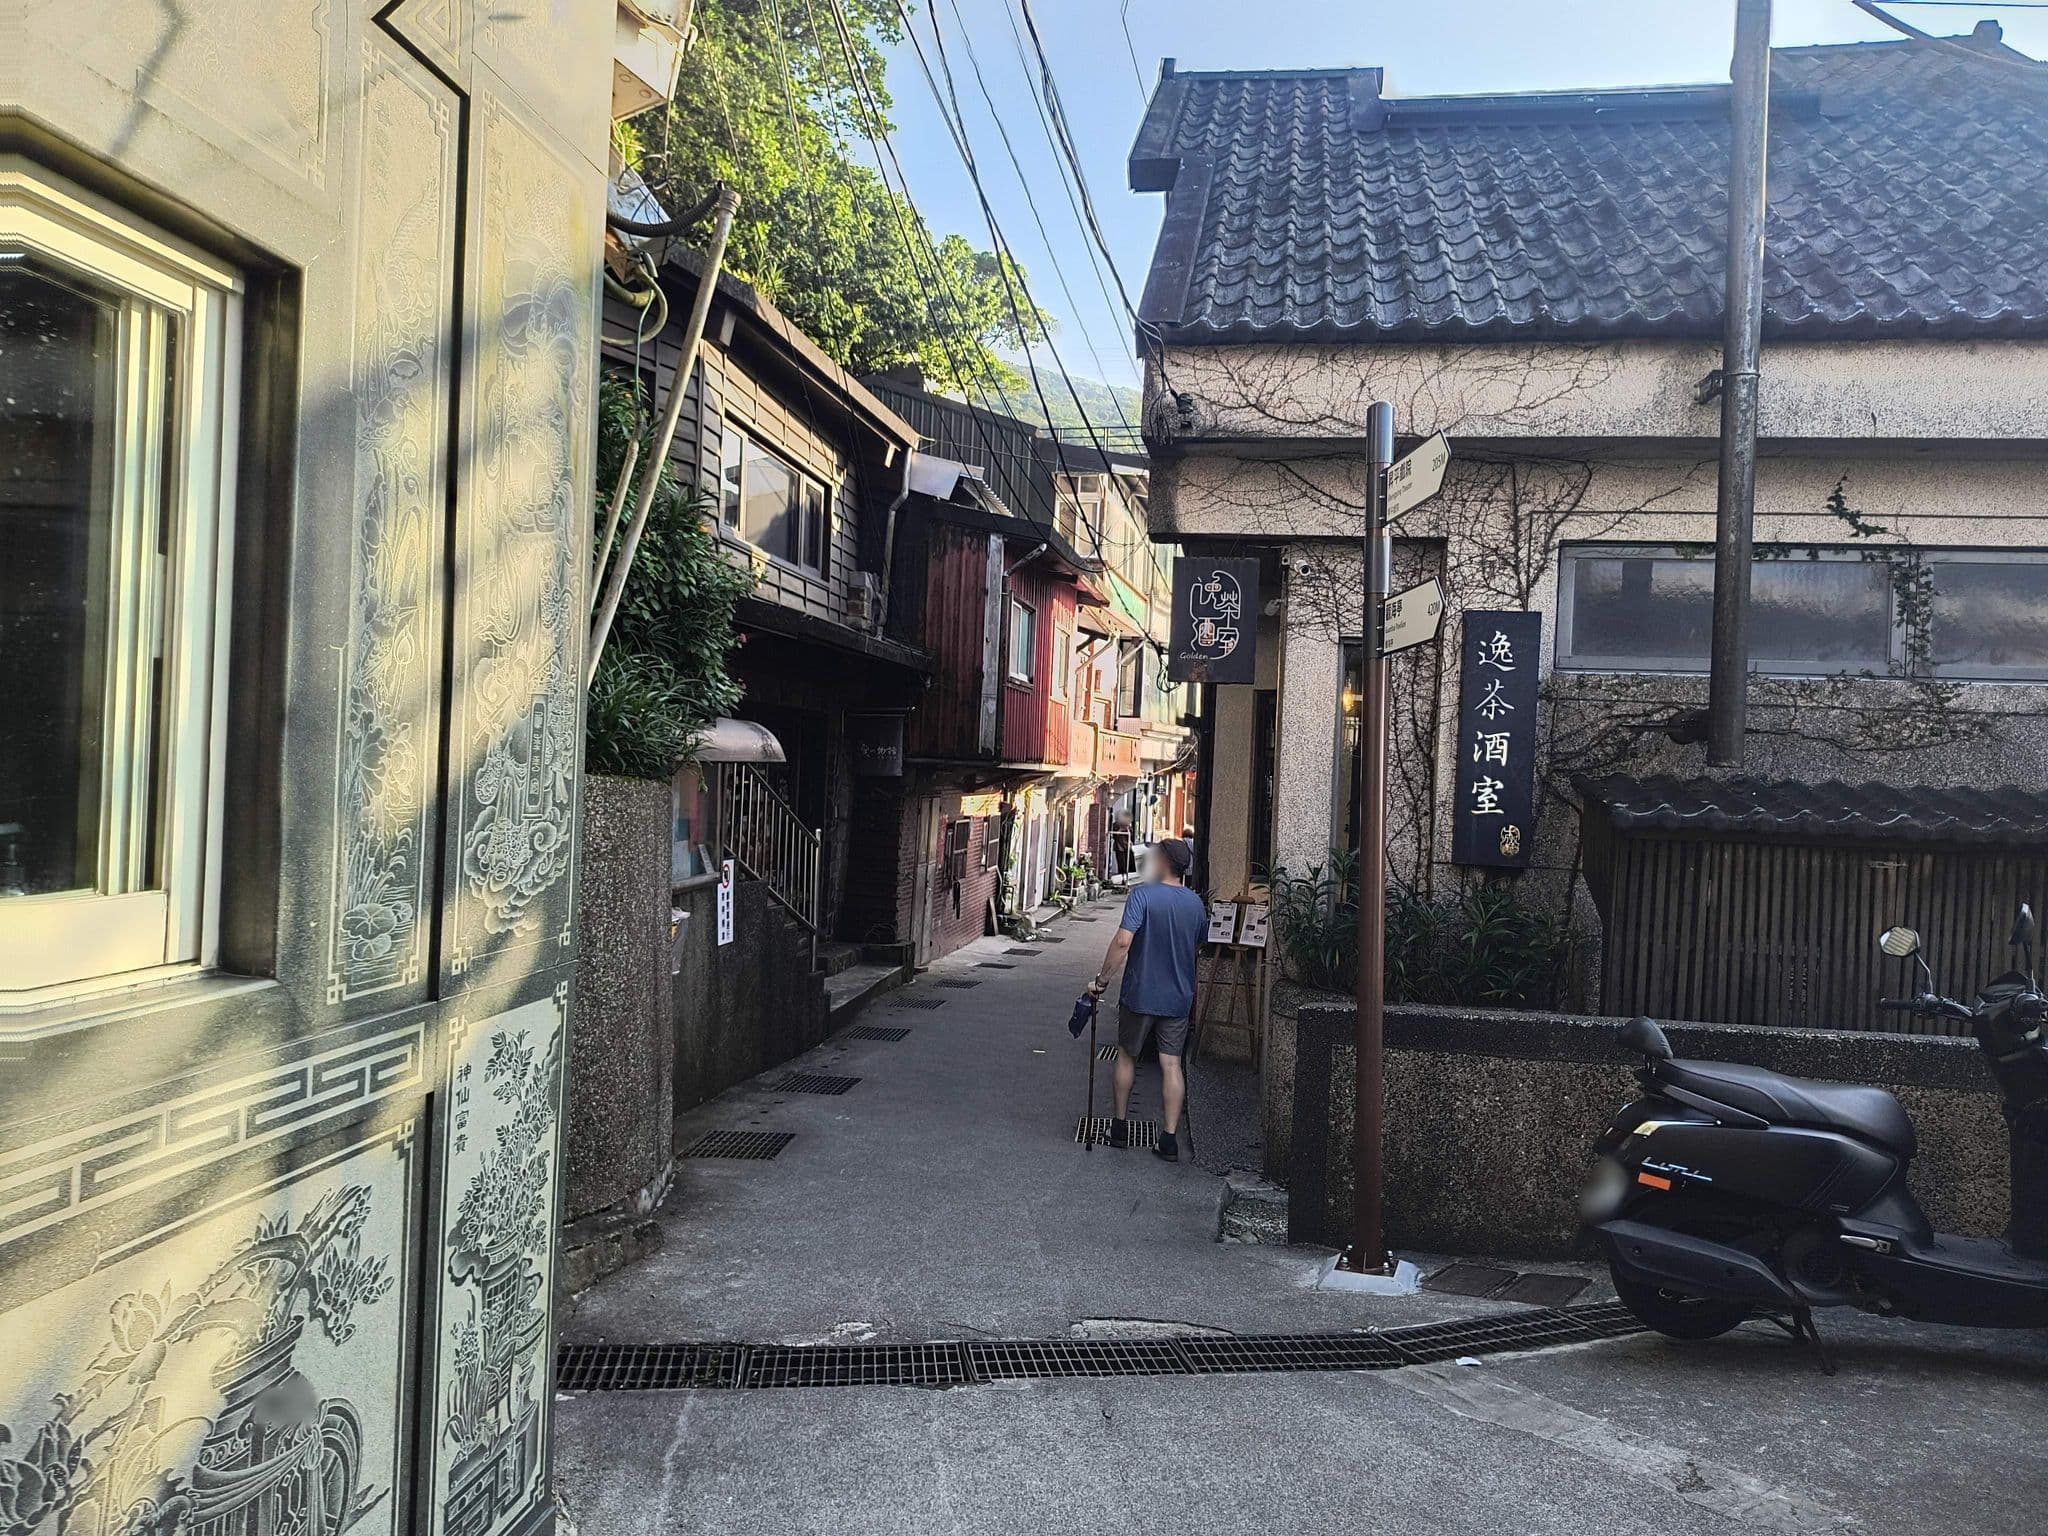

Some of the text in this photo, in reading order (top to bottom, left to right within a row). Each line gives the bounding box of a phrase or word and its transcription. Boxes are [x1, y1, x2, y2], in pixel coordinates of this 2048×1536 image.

[1471, 630, 1517, 815] 逸茶酒室
[454, 1062, 472, 1156] 神仙富貴
